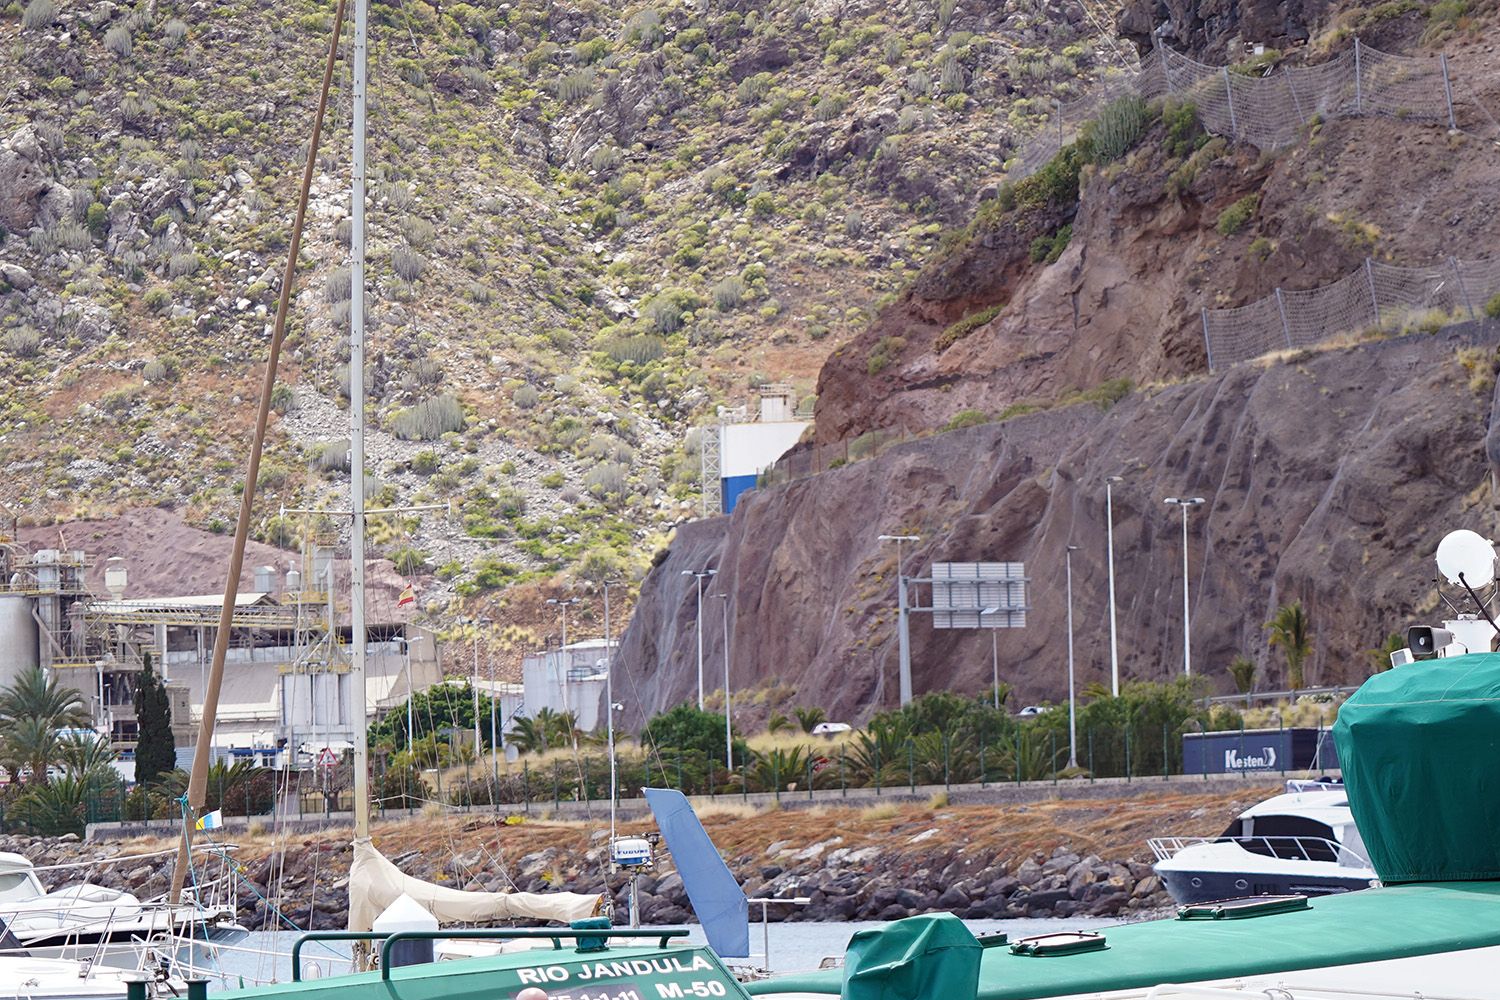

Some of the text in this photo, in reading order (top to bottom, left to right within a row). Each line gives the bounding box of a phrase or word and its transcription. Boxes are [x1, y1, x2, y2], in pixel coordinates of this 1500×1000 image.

[1225, 749, 1264, 768] Kesten
[516, 955, 714, 985] RIO JANDULA
[654, 980, 727, 999] M-50
